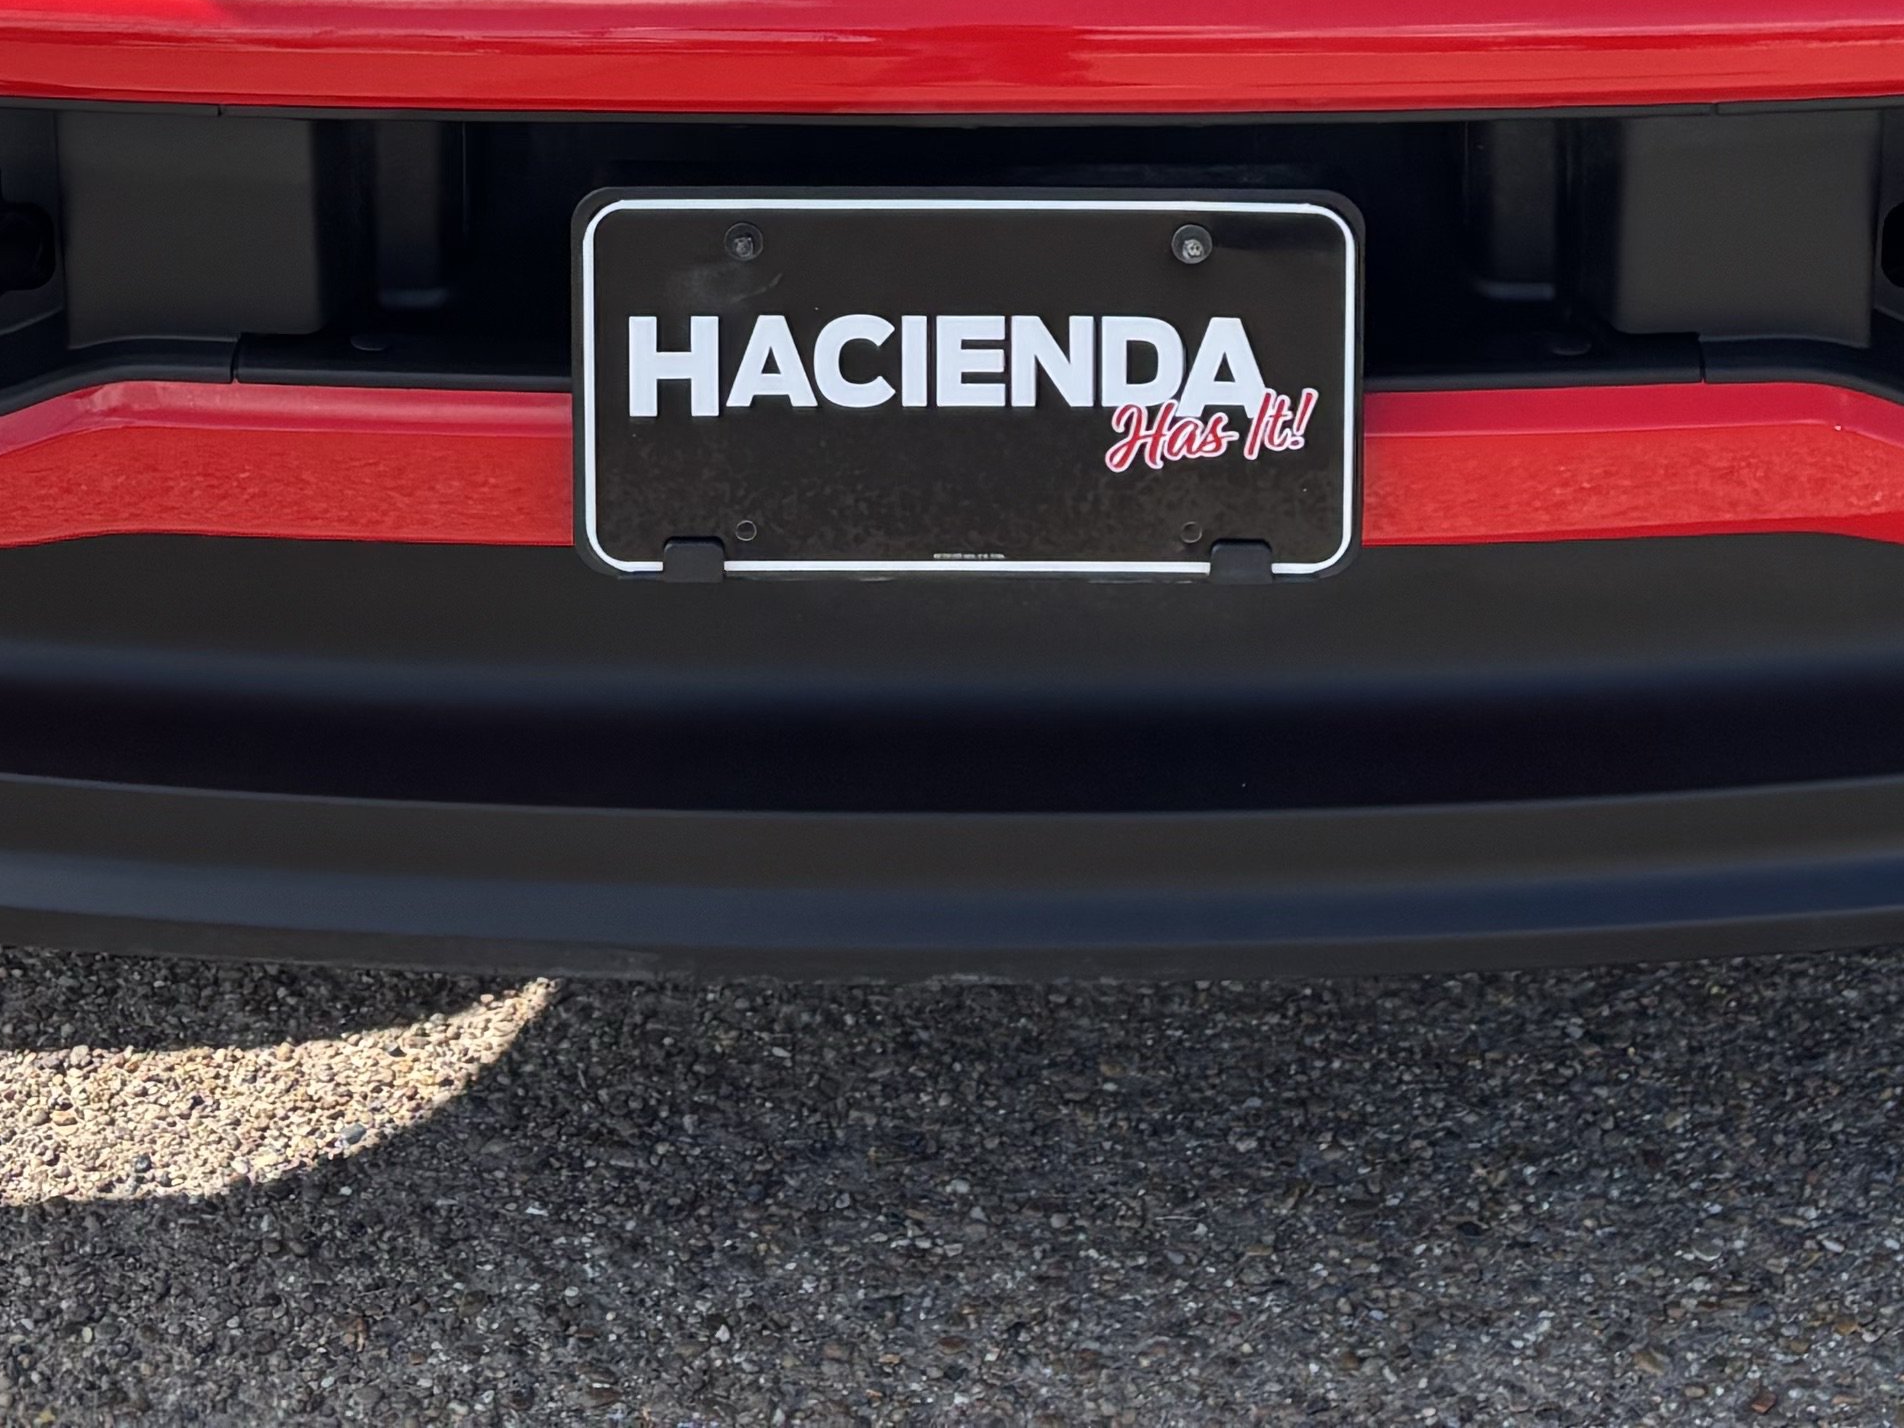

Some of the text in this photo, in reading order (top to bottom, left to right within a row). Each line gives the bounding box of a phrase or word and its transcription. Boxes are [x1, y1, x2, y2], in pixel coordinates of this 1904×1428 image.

[628, 314, 1268, 418] HACIENDA
[1105, 387, 1319, 473] Has It!
